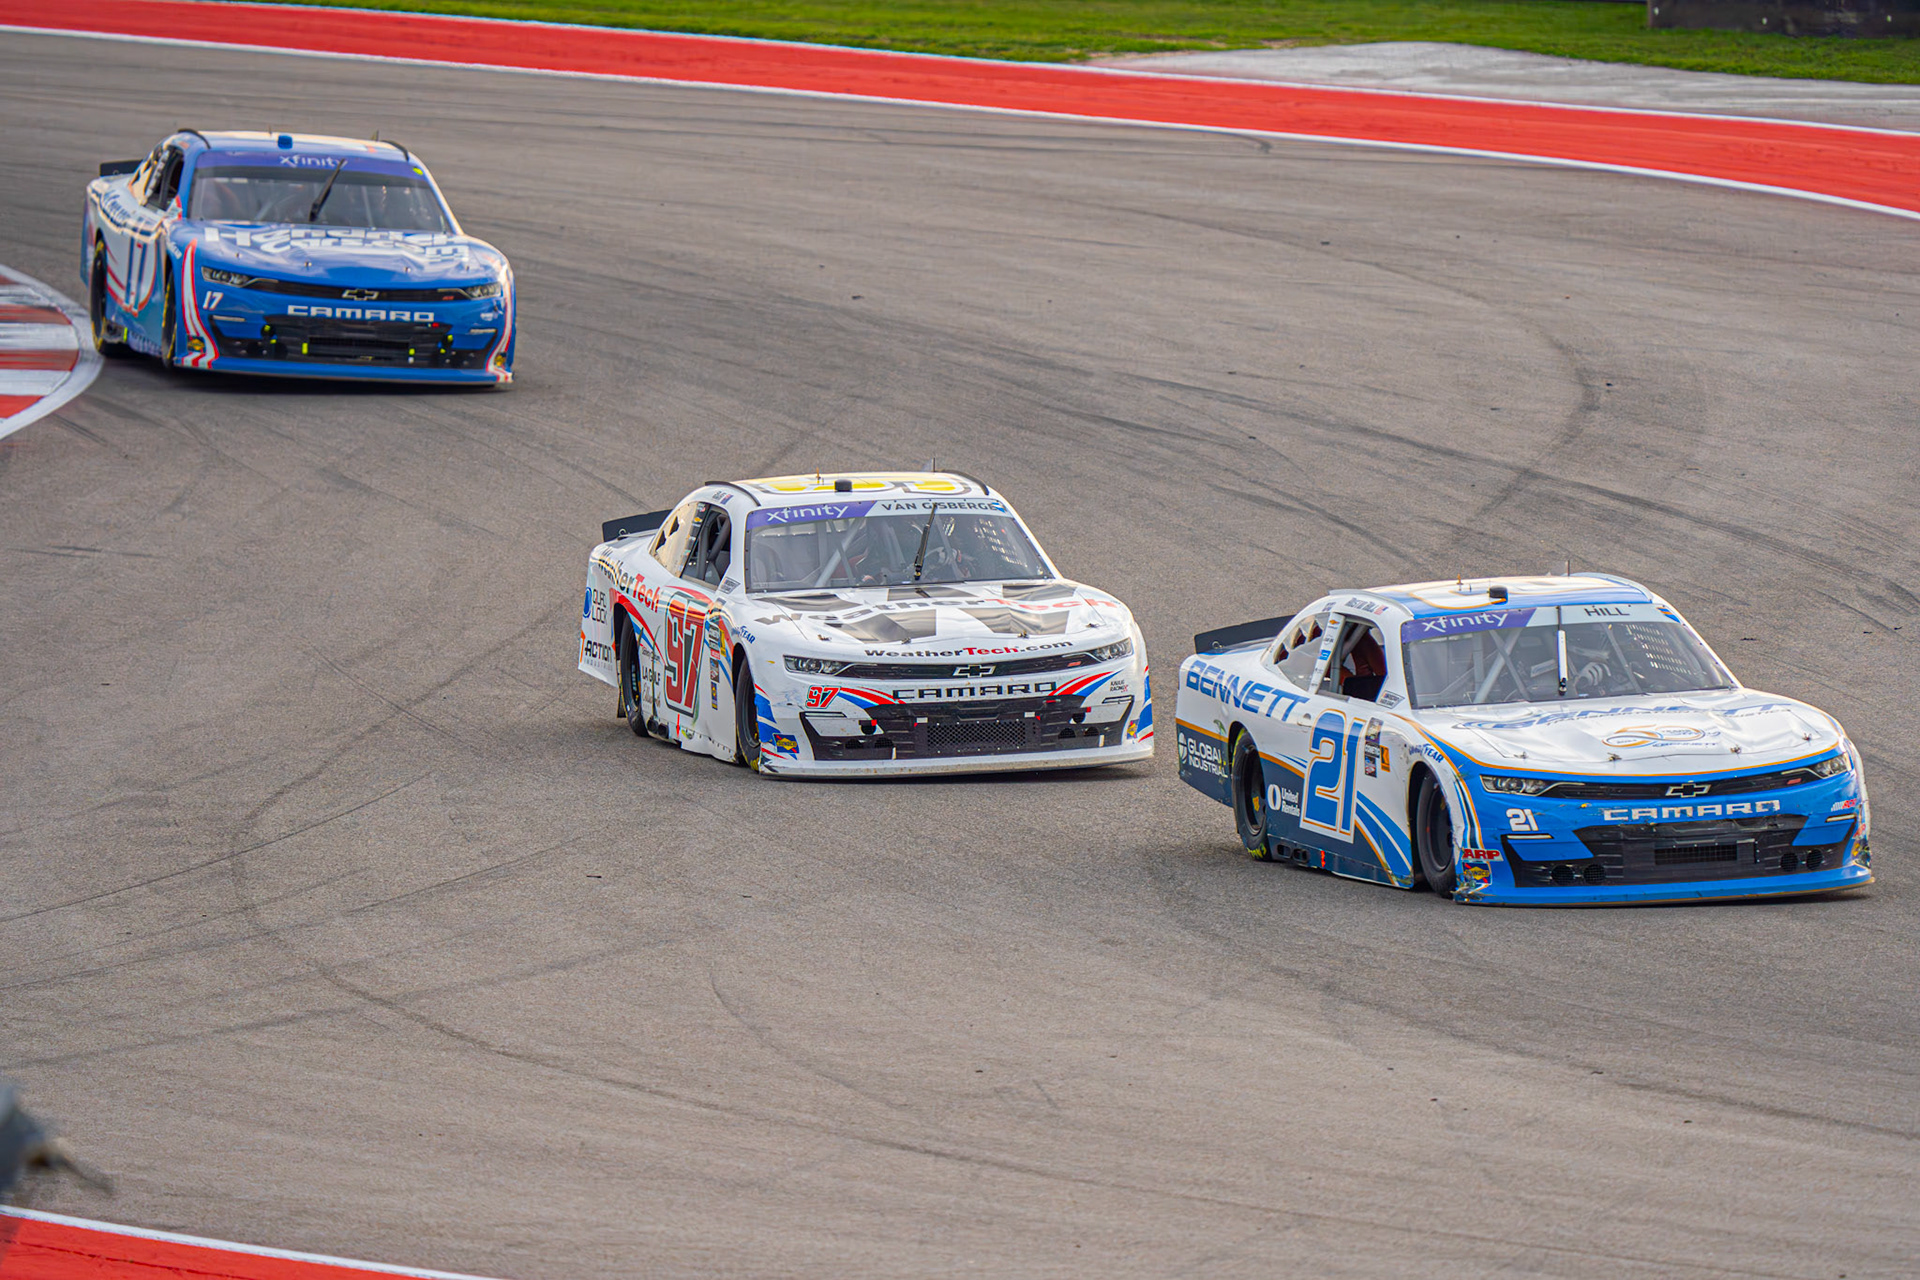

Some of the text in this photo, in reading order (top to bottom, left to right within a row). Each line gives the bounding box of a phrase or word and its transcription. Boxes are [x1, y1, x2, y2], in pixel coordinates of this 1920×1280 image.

[279, 154, 348, 168] xfinity
[202, 291, 224, 310] 17
[287, 304, 435, 322] CAMARO
[766, 504, 849, 523] xfinity
[881, 501, 1003, 512] VAN GISBERGE
[1421, 612, 1508, 633] xfinity
[1584, 607, 1630, 617] HILL
[584, 640, 612, 662] ACTION
[664, 591, 708, 718] 97
[805, 685, 841, 709] 97
[892, 681, 1057, 699] CAMARO
[1186, 660, 1312, 722] BENNETT
[1187, 738, 1222, 763] GLOBAL
[1188, 752, 1229, 778] INDUSTRIAL
[1303, 708, 1367, 836] 21
[1505, 808, 1540, 831] 21
[1603, 799, 1780, 821] CAMARO
[1462, 848, 1501, 860] ARP
